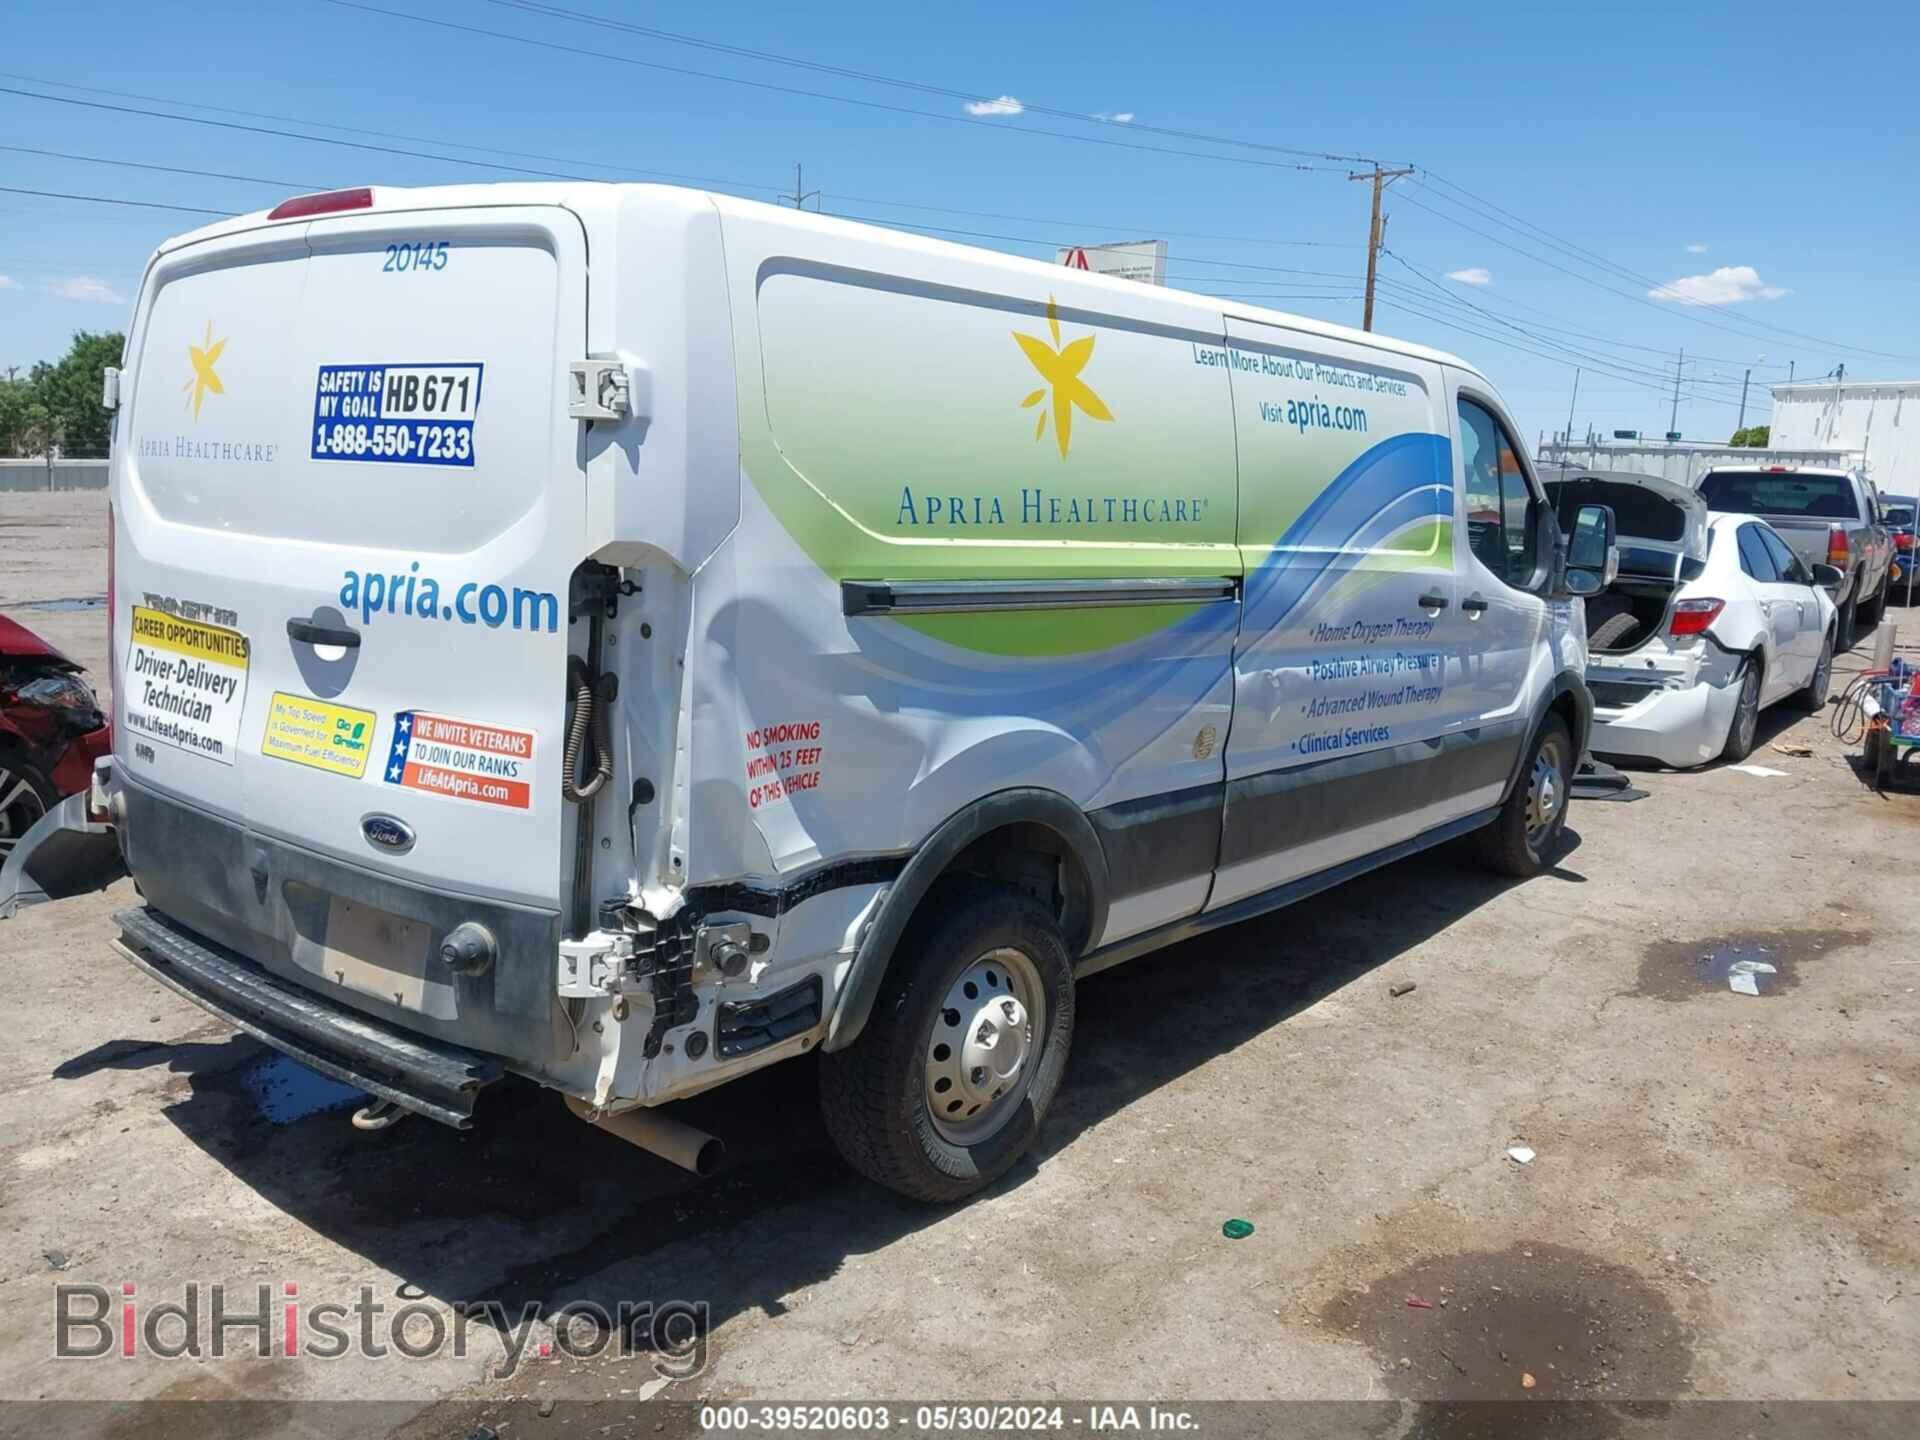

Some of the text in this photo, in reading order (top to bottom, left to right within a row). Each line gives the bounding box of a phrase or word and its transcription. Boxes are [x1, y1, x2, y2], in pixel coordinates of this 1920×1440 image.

[383, 241, 450, 272] 20145
[319, 371, 382, 393] SAFETY IS
[1193, 343, 1407, 396] Learn More About Our Products and Services
[319, 395, 377, 418] MY GOAL
[1259, 394, 1368, 434] Visit apria.com
[316, 423, 470, 459] 1-888-550-7233
[339, 561, 558, 633] apria.com
[134, 616, 248, 658] CAREER OPPORTUNITIES
[1314, 617, 1436, 645] Home Oxygen Therapy
[135, 648, 237, 703] Driver-Delivery
[1312, 652, 1437, 681] Positive Airway Pressure
[143, 680, 212, 723] Technician
[1307, 684, 1443, 719] Advanced Wound Therapy
[128, 712, 223, 754] www.LifeatApria.com
[336, 718, 352, 731] Go
[416, 718, 527, 754] WE INVITE VETERANS
[746, 721, 820, 751] NO SMOKING
[1299, 722, 1390, 754] Clinical Services
[333, 734, 365, 750] Green
[414, 743, 519, 777] TO JOIN OUR RANKS
[746, 747, 822, 779] WITHIN 25 FEET
[417, 767, 509, 801] LifeAtApria.com
[750, 771, 820, 808] OF THIS VEHICLE
